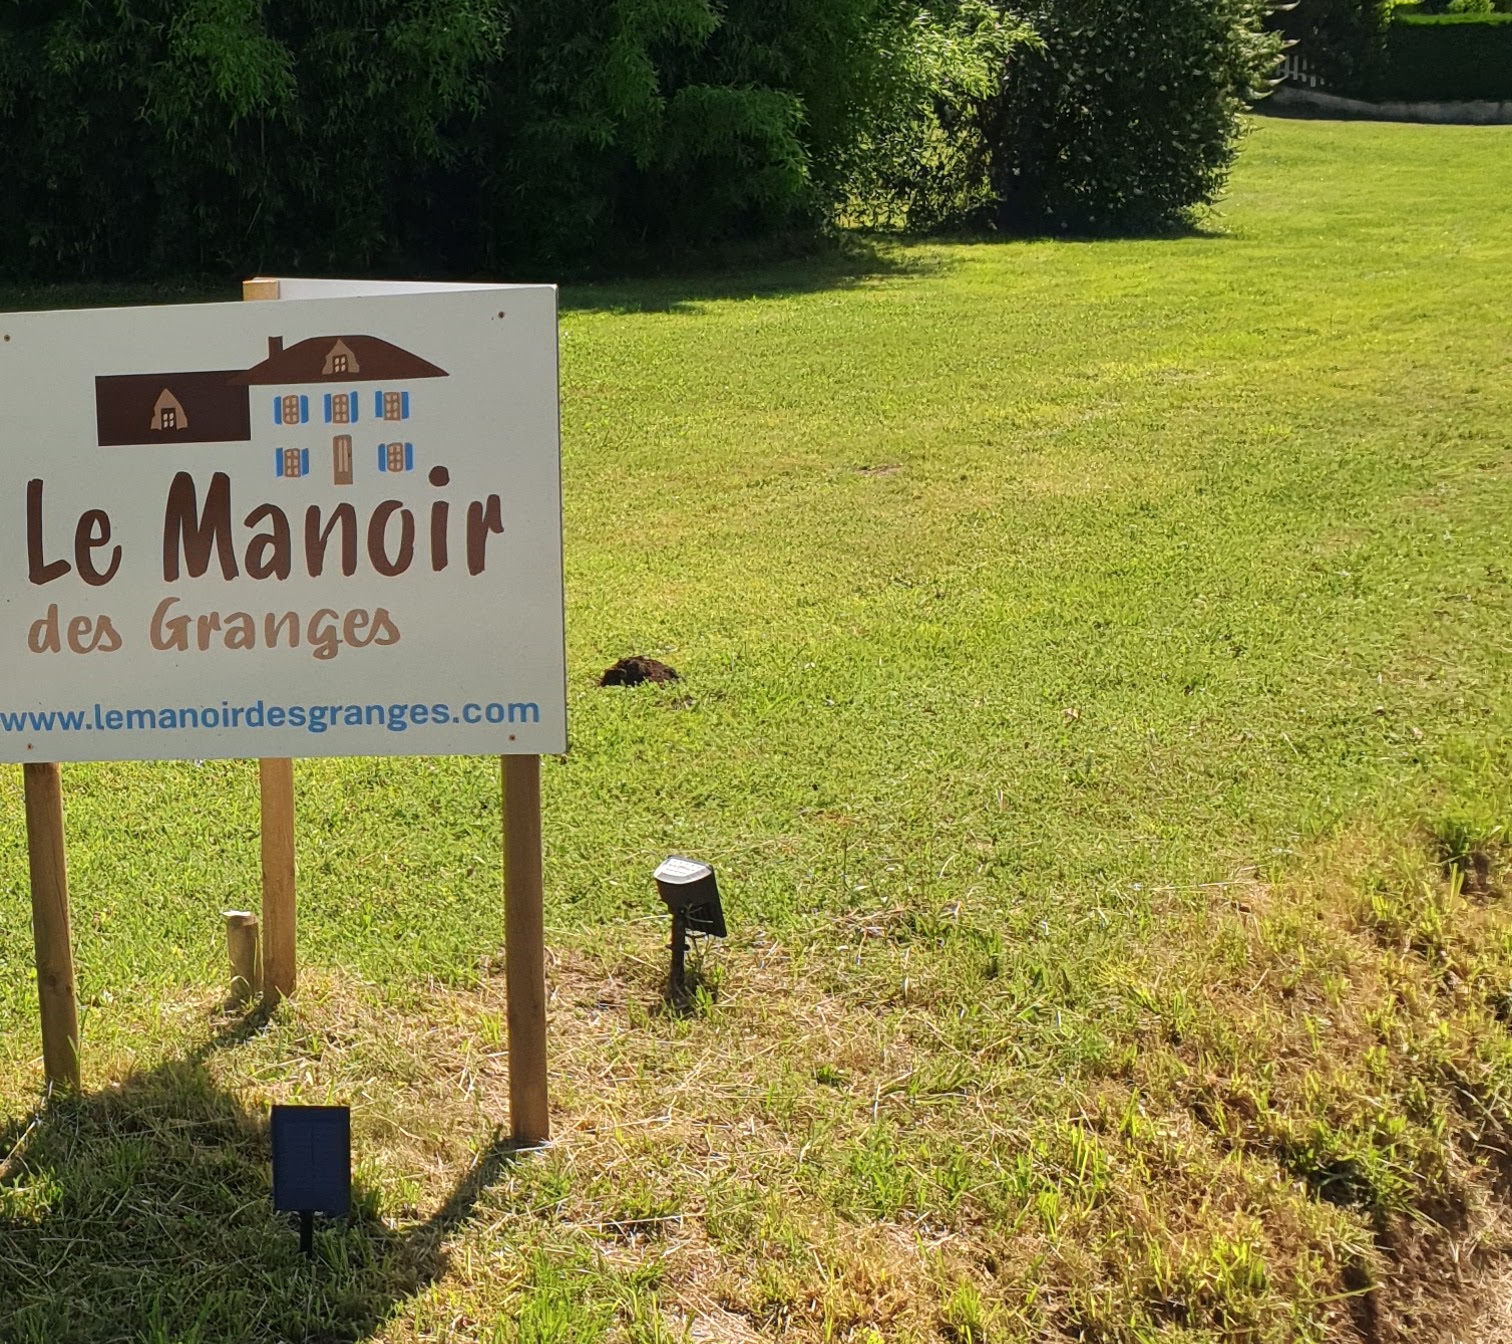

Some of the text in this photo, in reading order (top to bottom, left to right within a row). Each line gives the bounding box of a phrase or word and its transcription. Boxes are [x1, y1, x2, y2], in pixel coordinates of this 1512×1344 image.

[26, 466, 504, 586] Le Manoir
[27, 597, 401, 660] des Granges
[0, 699, 541, 733] www.lemanoirdesgranges.com
